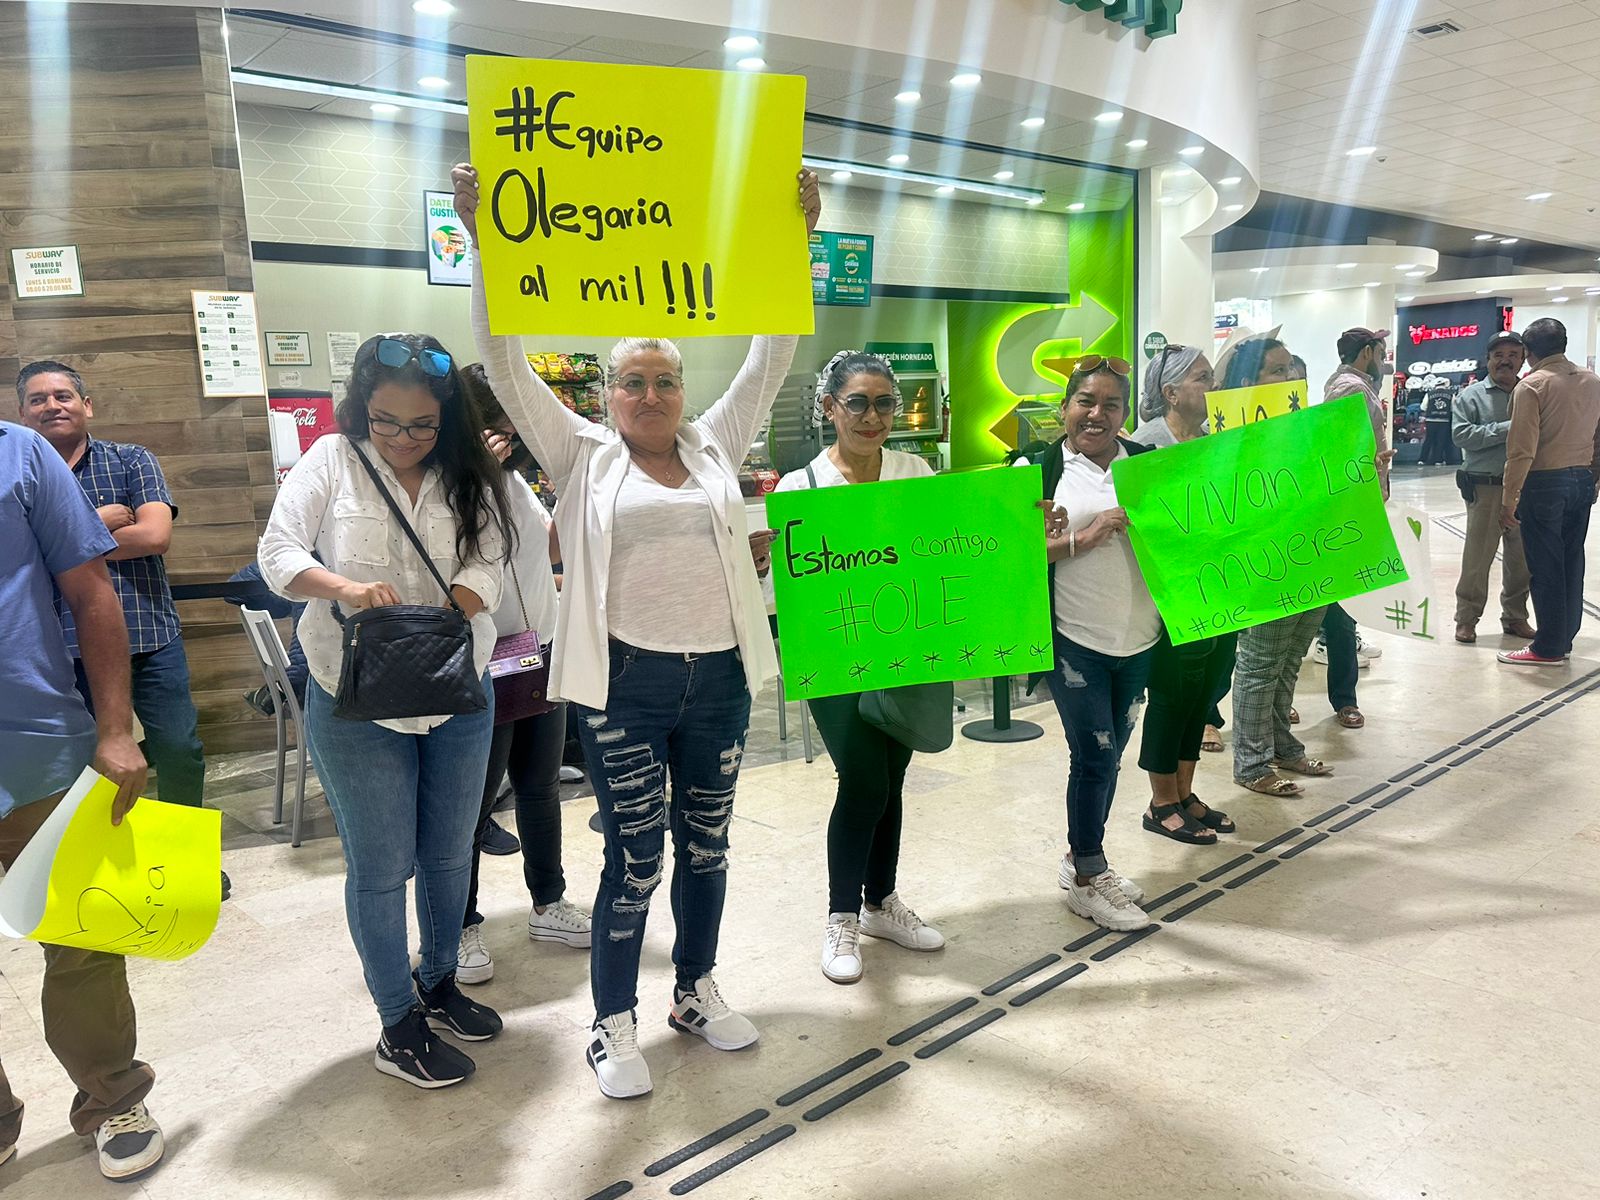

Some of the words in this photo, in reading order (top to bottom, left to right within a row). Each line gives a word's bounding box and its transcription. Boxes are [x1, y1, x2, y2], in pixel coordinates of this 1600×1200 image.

[494, 86, 664, 159] #Equipo
[491, 166, 673, 244] Olegaria
[25, 250, 64, 259] SUBWAY
[519, 264, 549, 302] al
[900, 353, 933, 361] HORNEADO
[785, 519, 899, 579] Estamos
[824, 575, 970, 645] #OLE
[1384, 596, 1435, 640] #1
